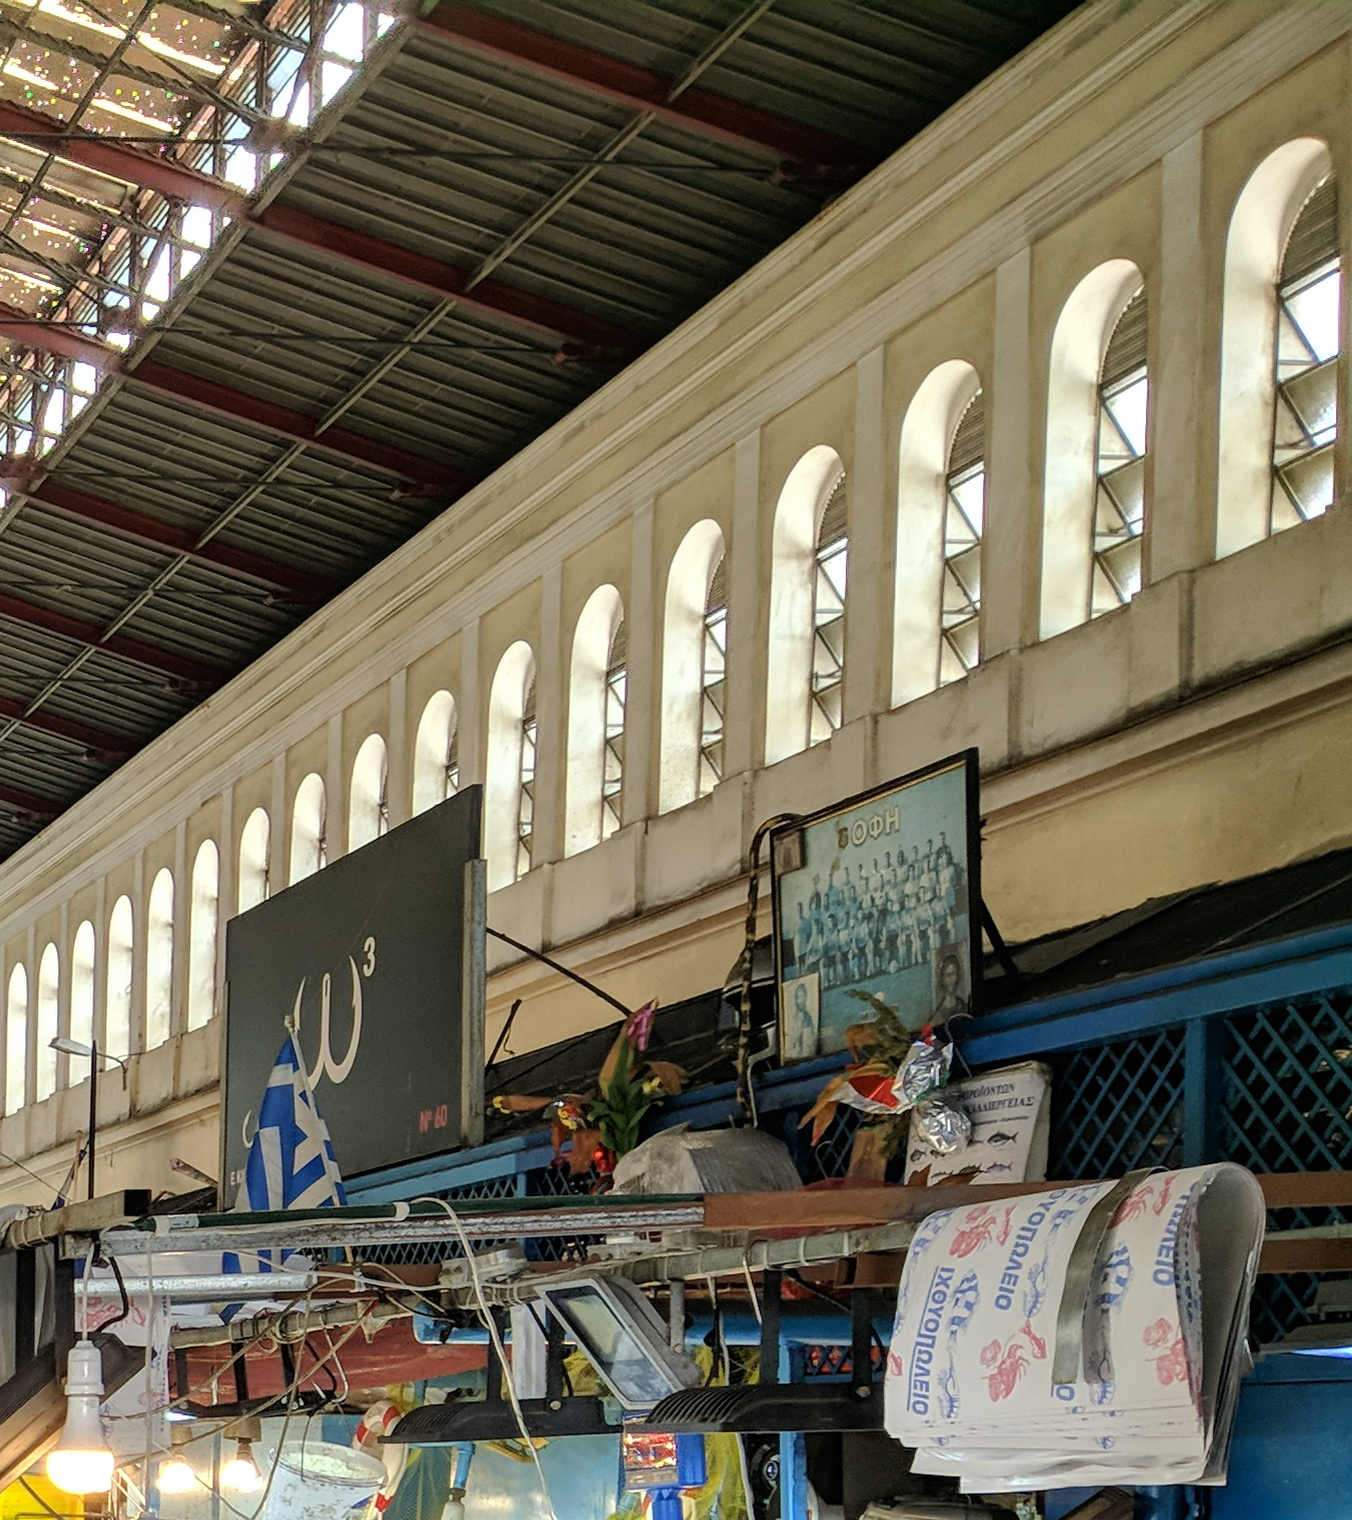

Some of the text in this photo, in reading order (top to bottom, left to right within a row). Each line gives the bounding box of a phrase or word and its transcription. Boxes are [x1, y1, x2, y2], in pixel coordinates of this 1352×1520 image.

[851, 806, 901, 846] ΟΦΗ
[434, 1104, 449, 1129] 60
[910, 1266, 956, 1417] ΙΧΘΥΟΠΩΛΕΙΟ
